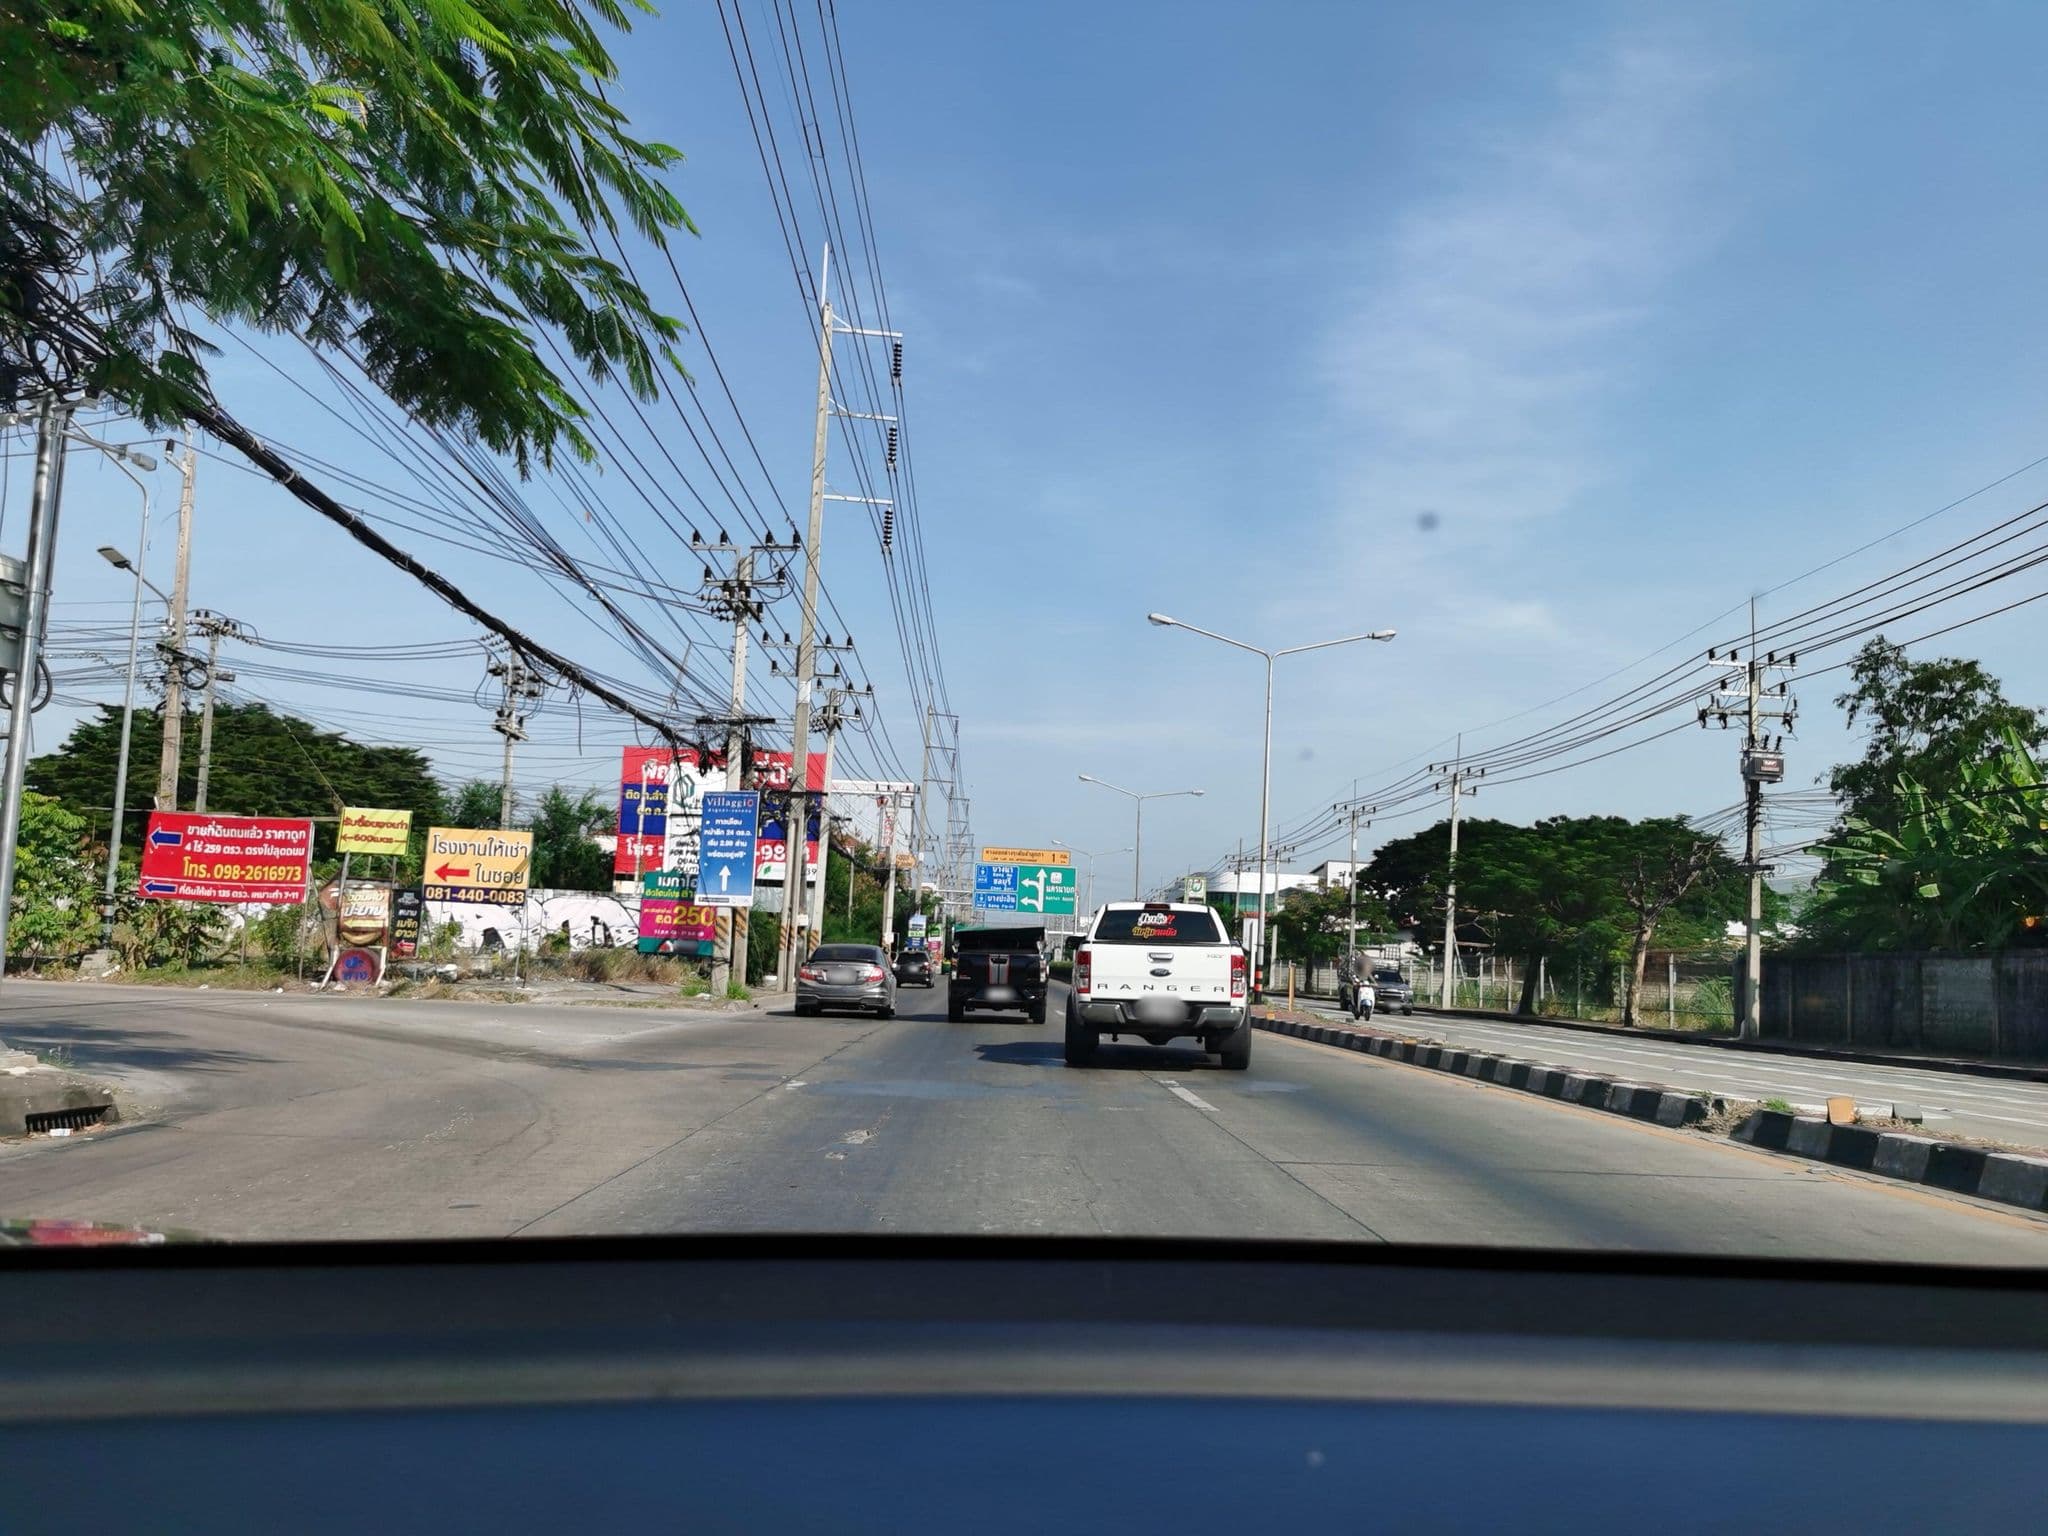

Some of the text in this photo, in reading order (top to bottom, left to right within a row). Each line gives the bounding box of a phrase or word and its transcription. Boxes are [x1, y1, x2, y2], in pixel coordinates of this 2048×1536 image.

[265, 829, 307, 844] ราคาถูก
[432, 834, 528, 858] โรงงานให้เช่า
[184, 842, 192, 851] 4
[193, 839, 203, 853] ไร่
[203, 843, 222, 854] 259
[183, 856, 302, 881] โทร. 098-2616973
[475, 862, 524, 884] ในซอย
[425, 887, 525, 903] 081-440-0083
[673, 905, 715, 928] 250
[1096, 983, 1225, 993] RANGER
